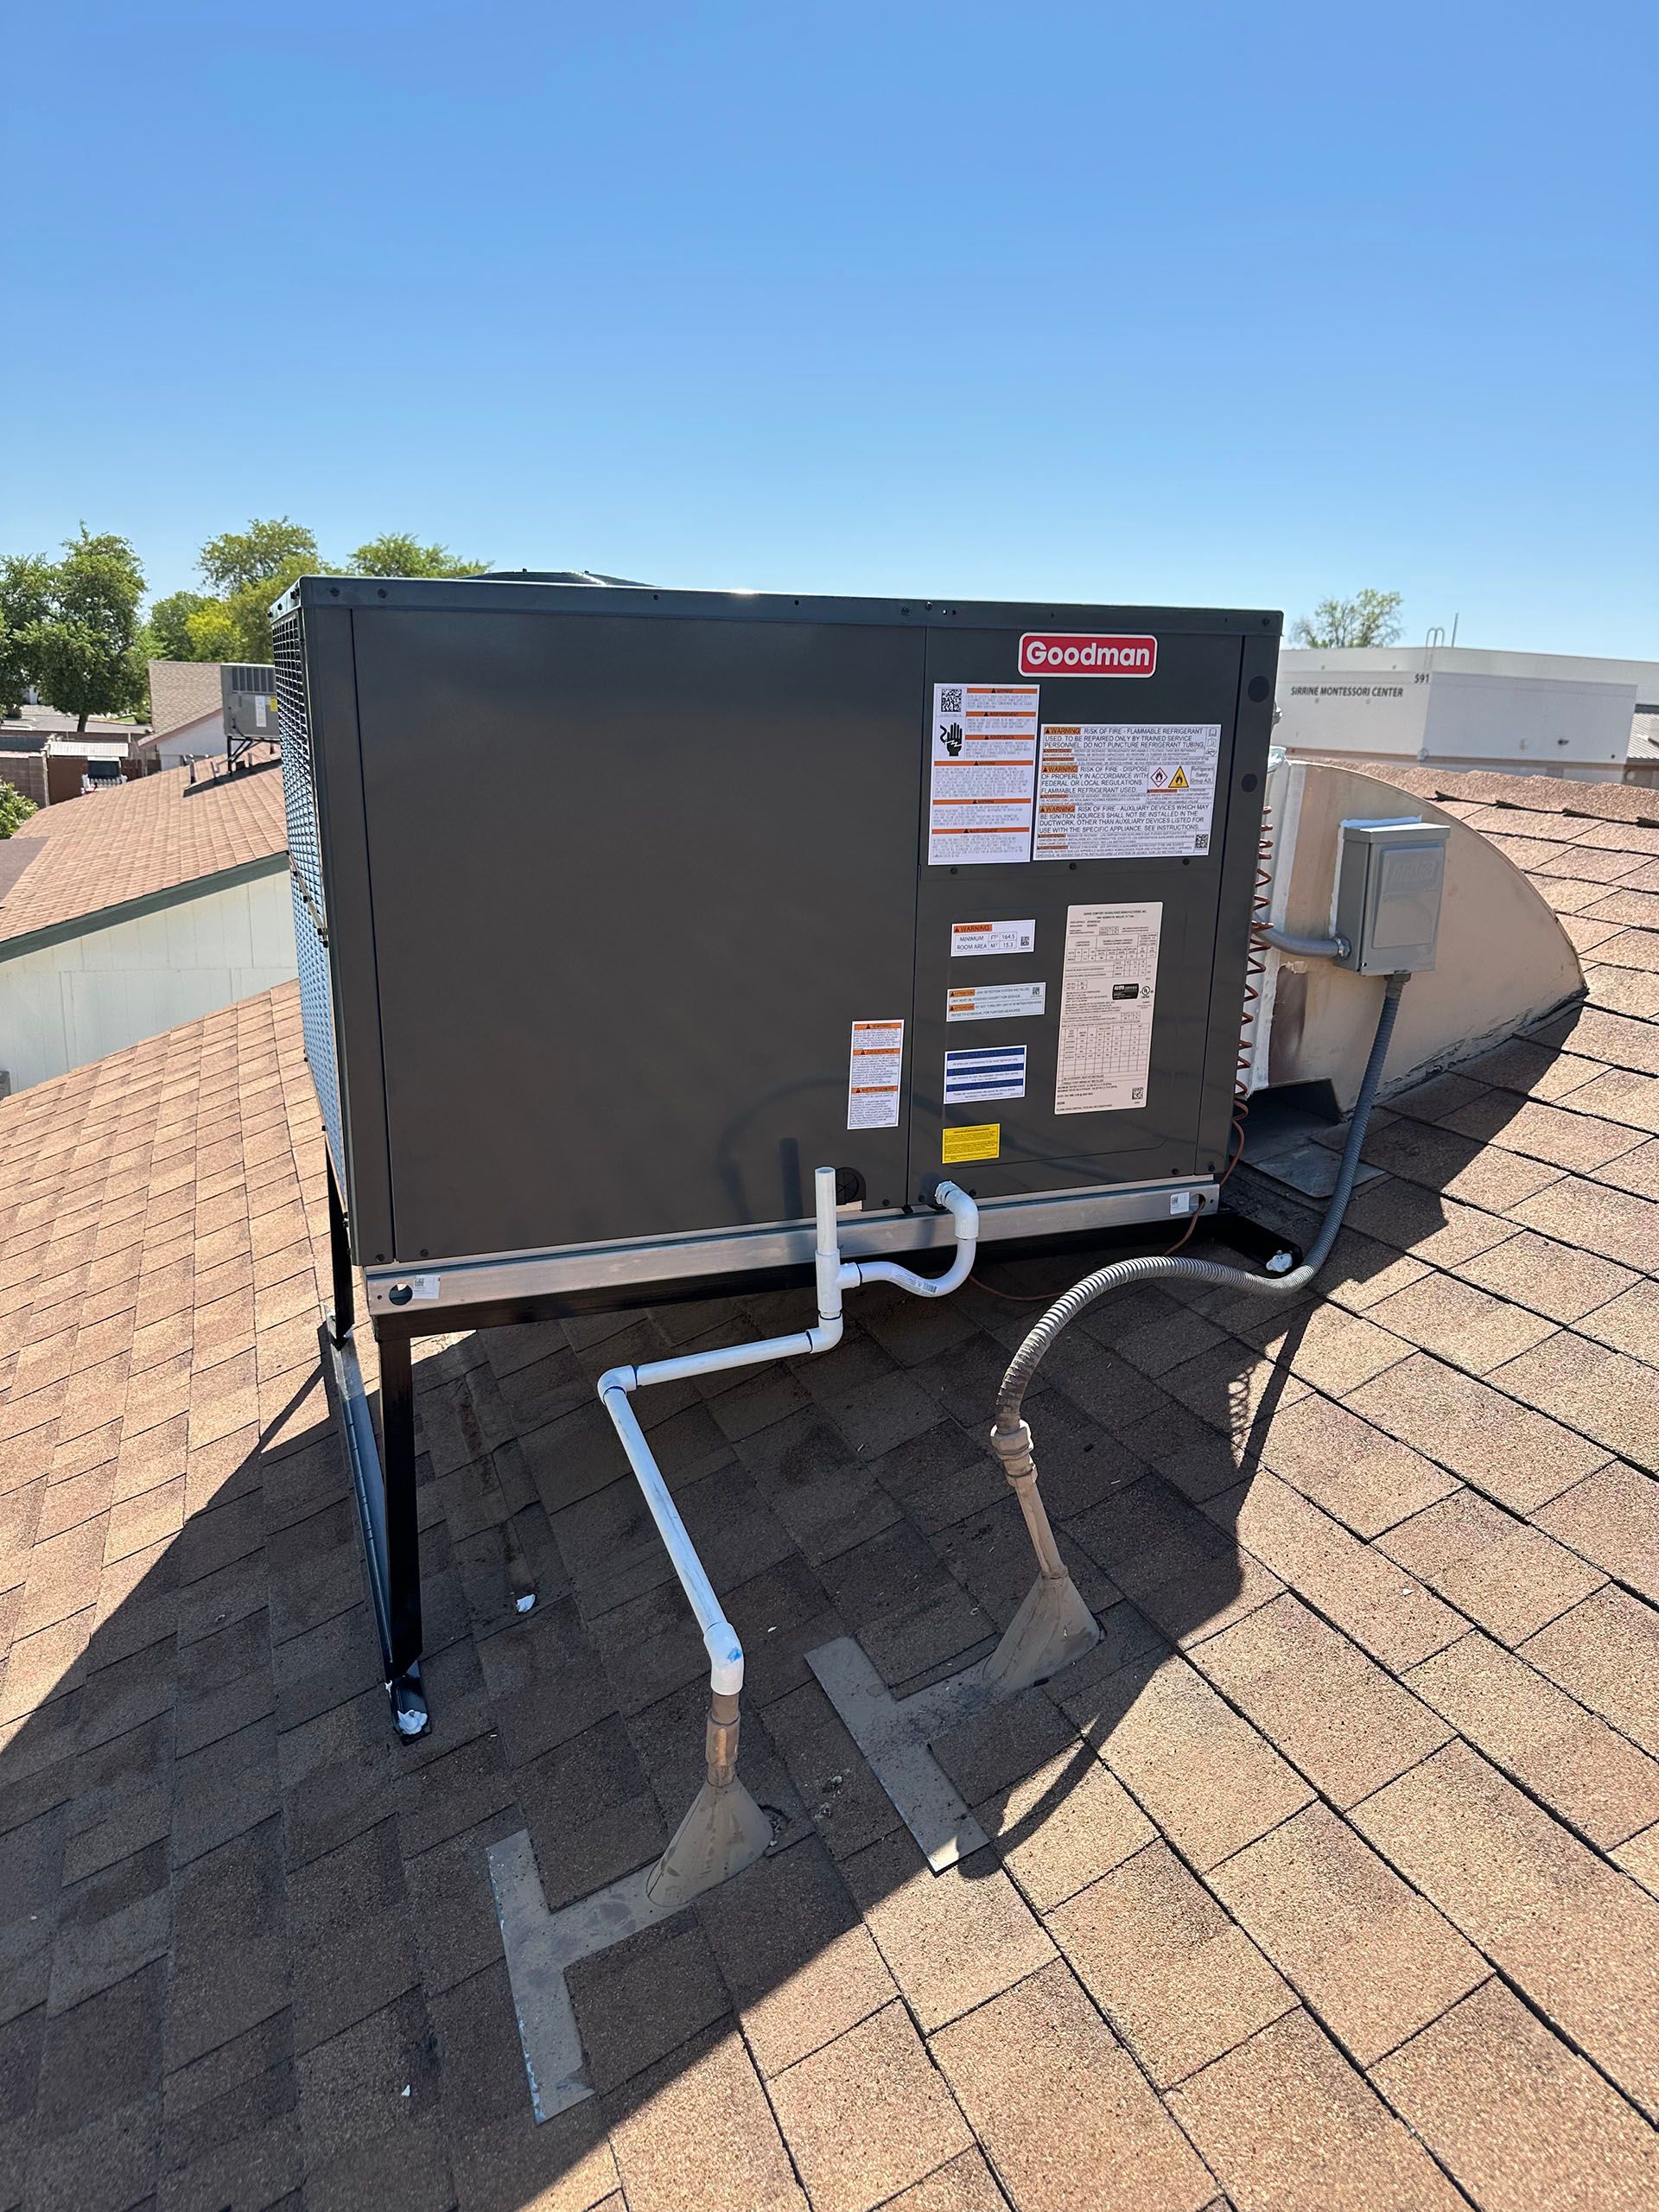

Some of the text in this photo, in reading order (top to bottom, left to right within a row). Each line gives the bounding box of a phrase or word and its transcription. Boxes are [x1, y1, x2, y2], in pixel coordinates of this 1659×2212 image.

[1027, 641, 1150, 665] Goodman
[1414, 674, 1429, 683] 591
[1291, 687, 1403, 697] SIRRINE MONTESSORI CENTER
